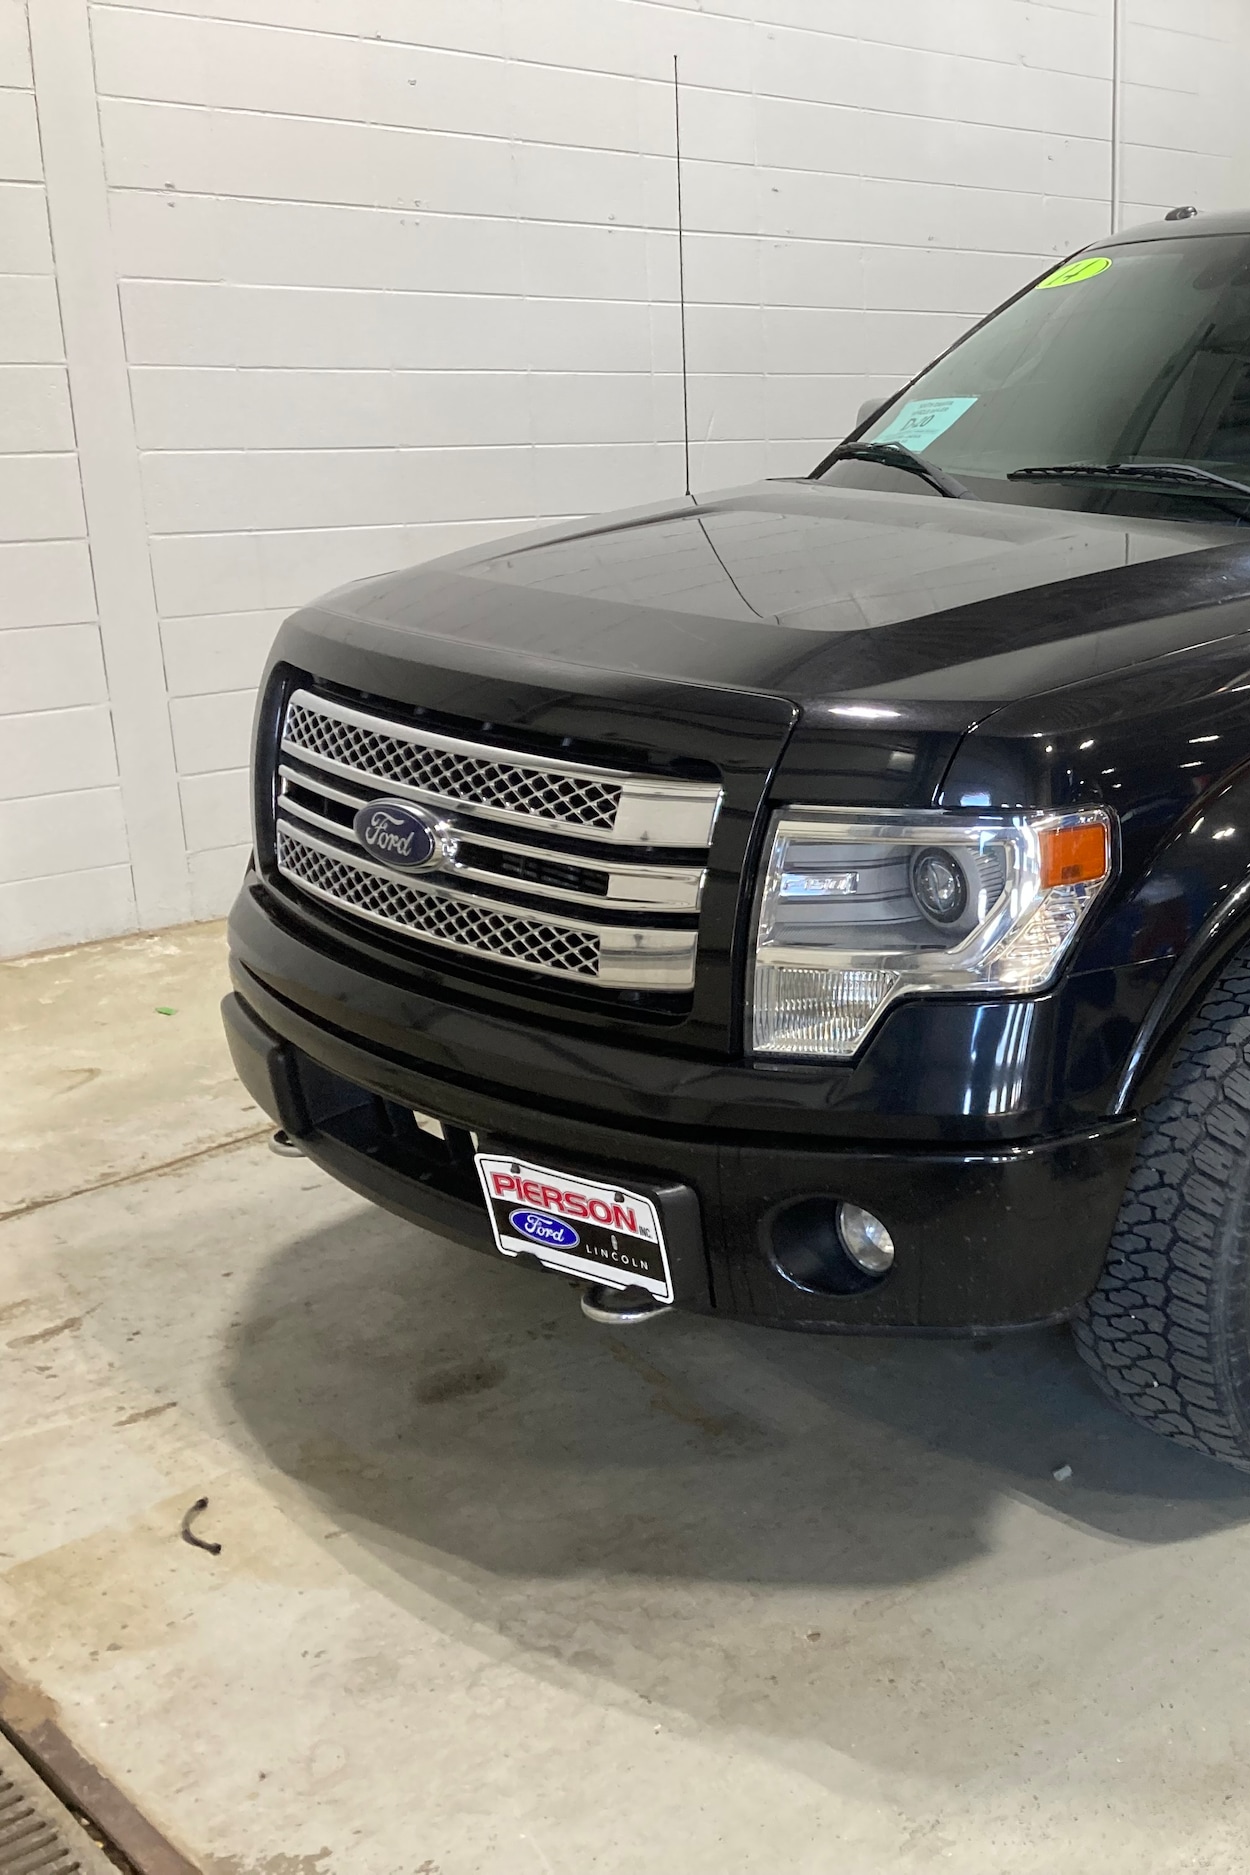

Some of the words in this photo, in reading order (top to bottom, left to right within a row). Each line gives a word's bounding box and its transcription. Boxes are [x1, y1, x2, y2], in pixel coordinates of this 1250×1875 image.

[365, 811, 415, 857] Ford
[490, 1171, 639, 1234] PIERSON
[524, 1214, 565, 1243] Ford
[585, 1244, 649, 1270] LINCOLN
